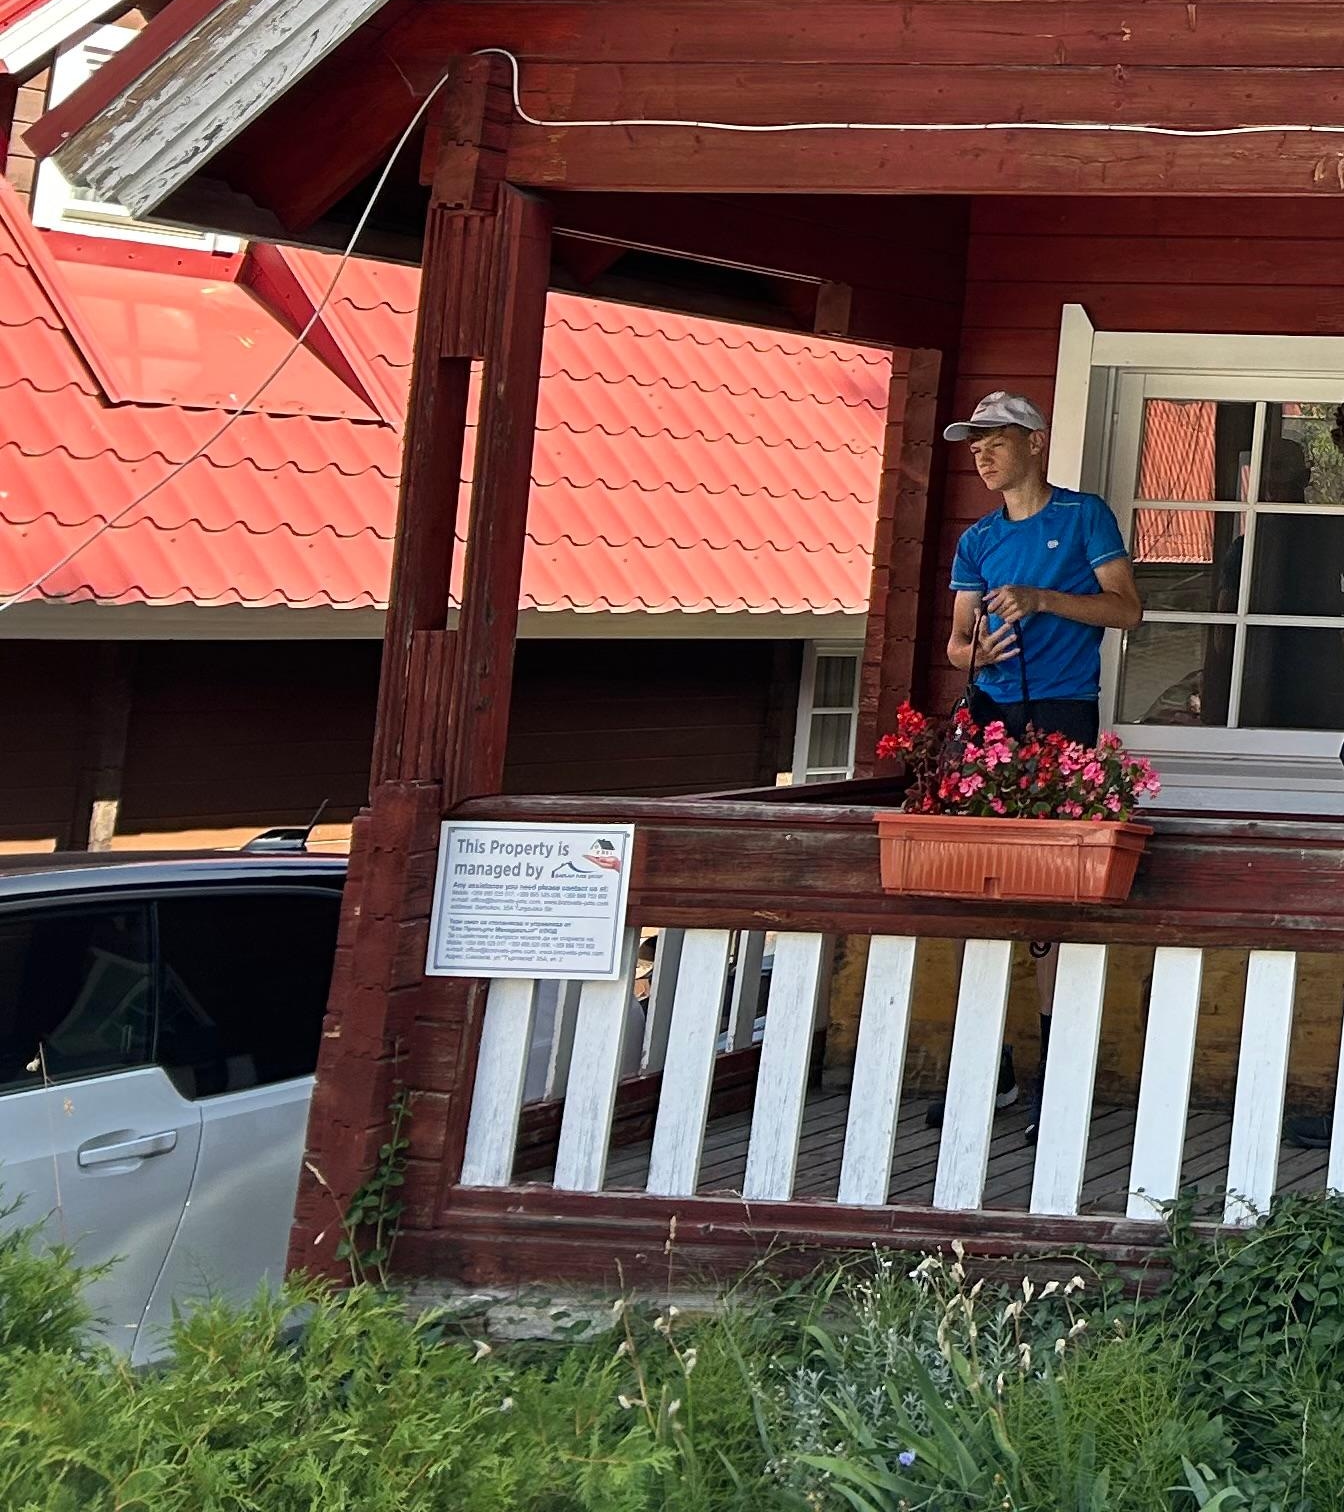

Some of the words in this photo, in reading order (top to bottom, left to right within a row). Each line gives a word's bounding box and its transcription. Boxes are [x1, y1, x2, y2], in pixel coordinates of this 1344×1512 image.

[457, 838, 486, 854] This
[489, 840, 554, 859] Property
[557, 841, 570, 857] is
[454, 862, 522, 879] managed
[525, 862, 545, 881] by
